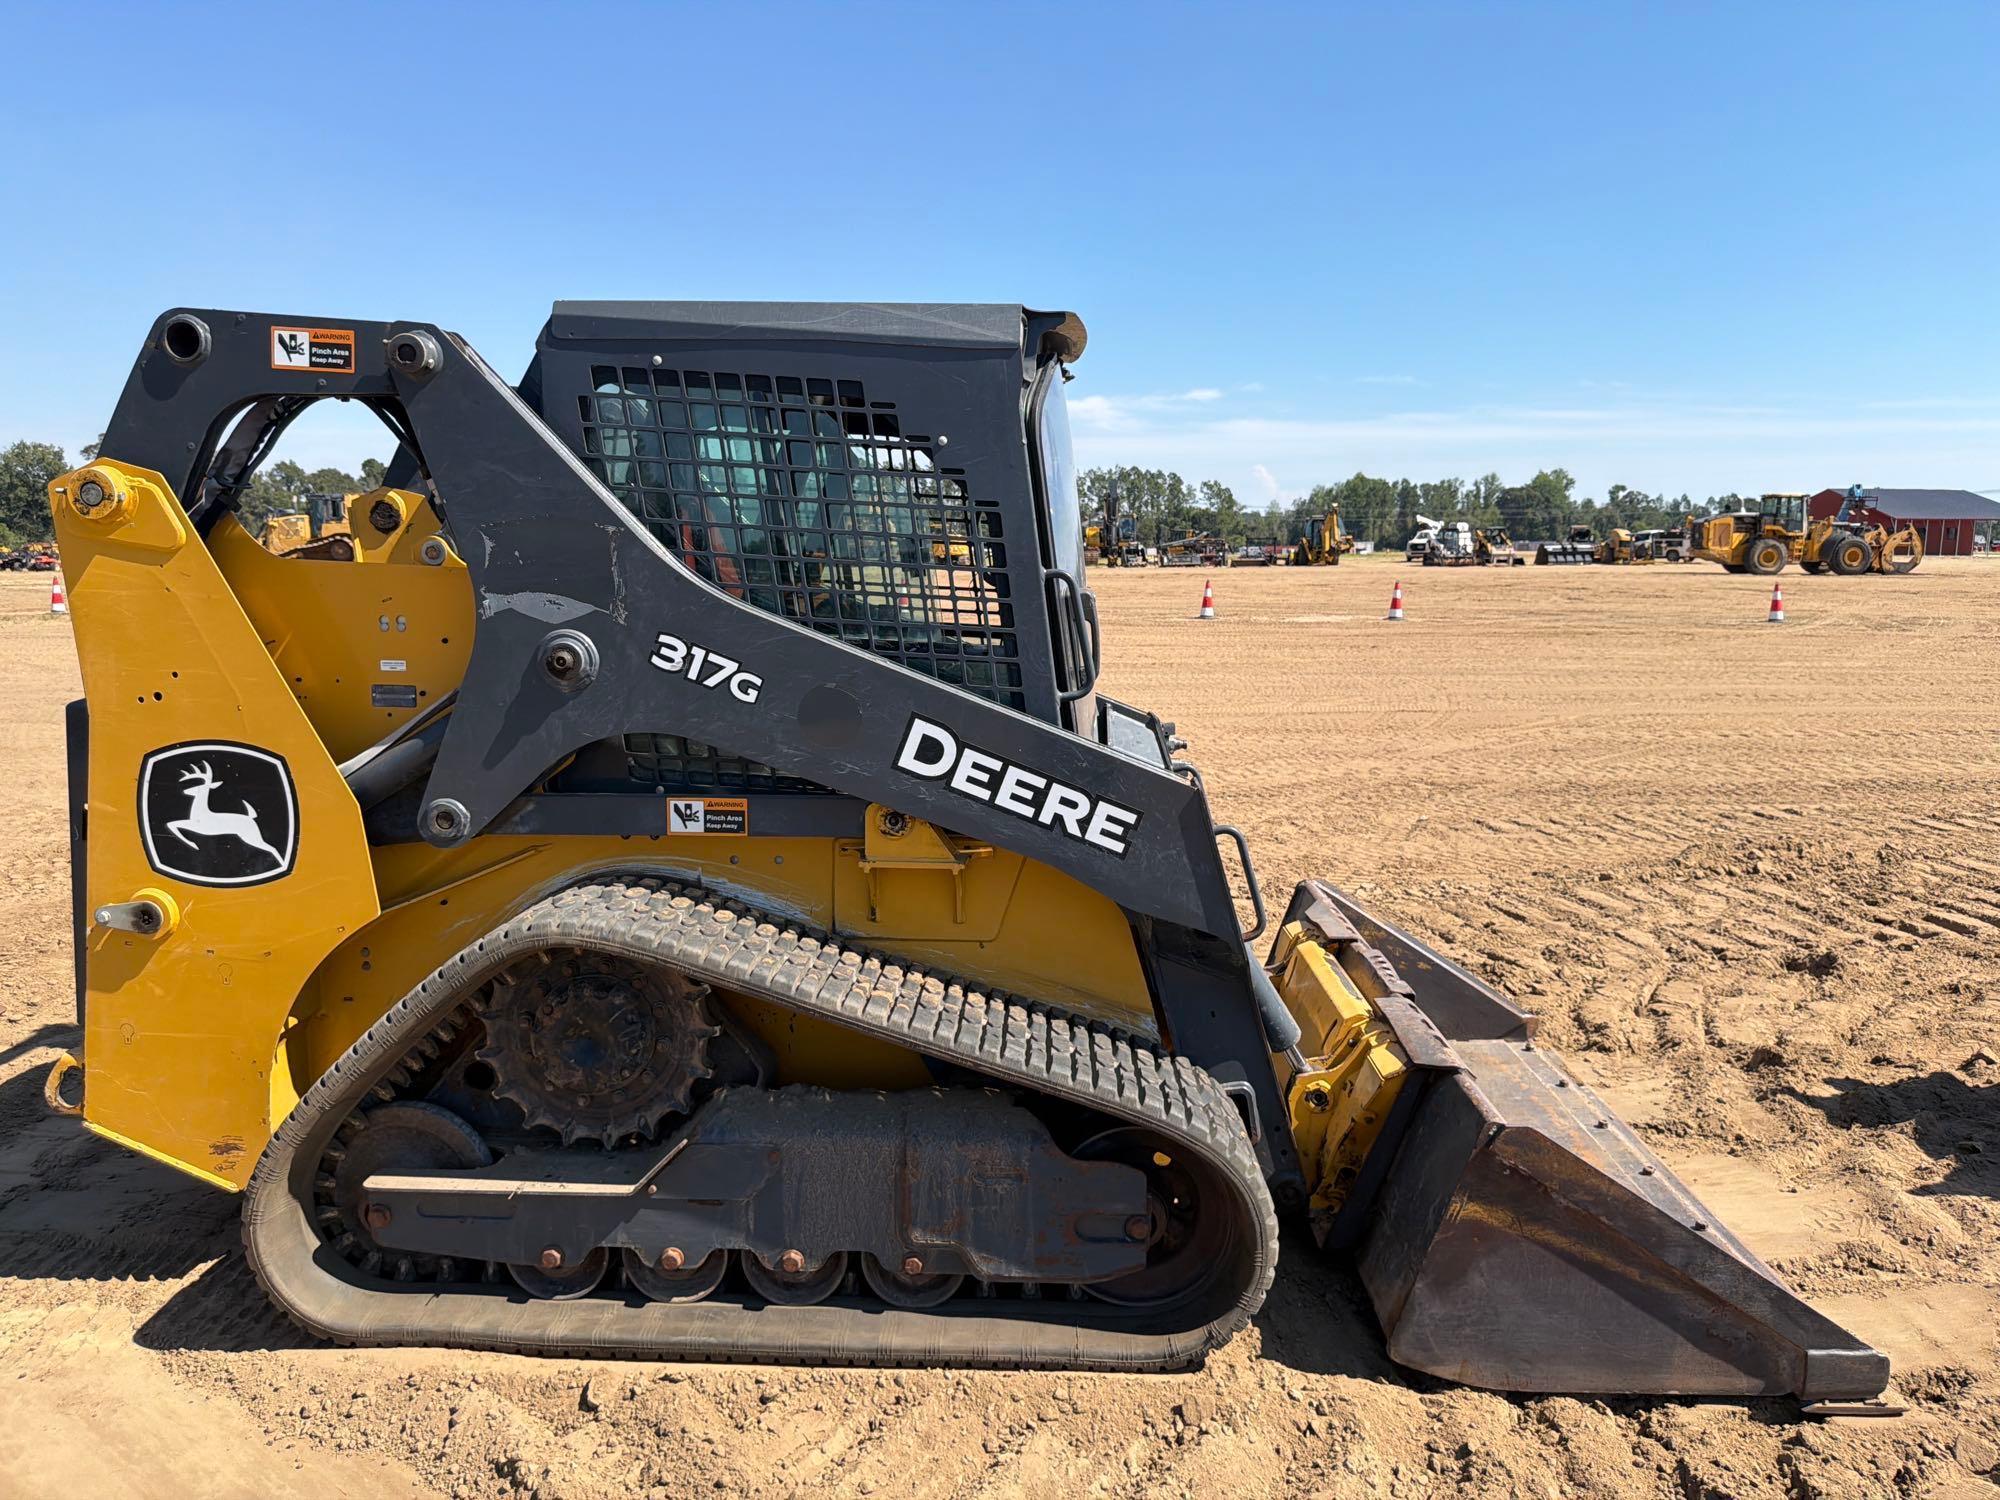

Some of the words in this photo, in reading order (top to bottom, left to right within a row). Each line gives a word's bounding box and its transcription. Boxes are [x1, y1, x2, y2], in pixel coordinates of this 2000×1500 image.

[319, 333, 351, 341] WARNING
[311, 347, 332, 355] Pinch
[333, 348, 350, 356] Area
[311, 356, 327, 364] Keep
[328, 357, 344, 365] Away
[650, 633, 763, 704] 317G
[897, 717, 1138, 854] DEERE
[706, 822, 721, 830] Keep
